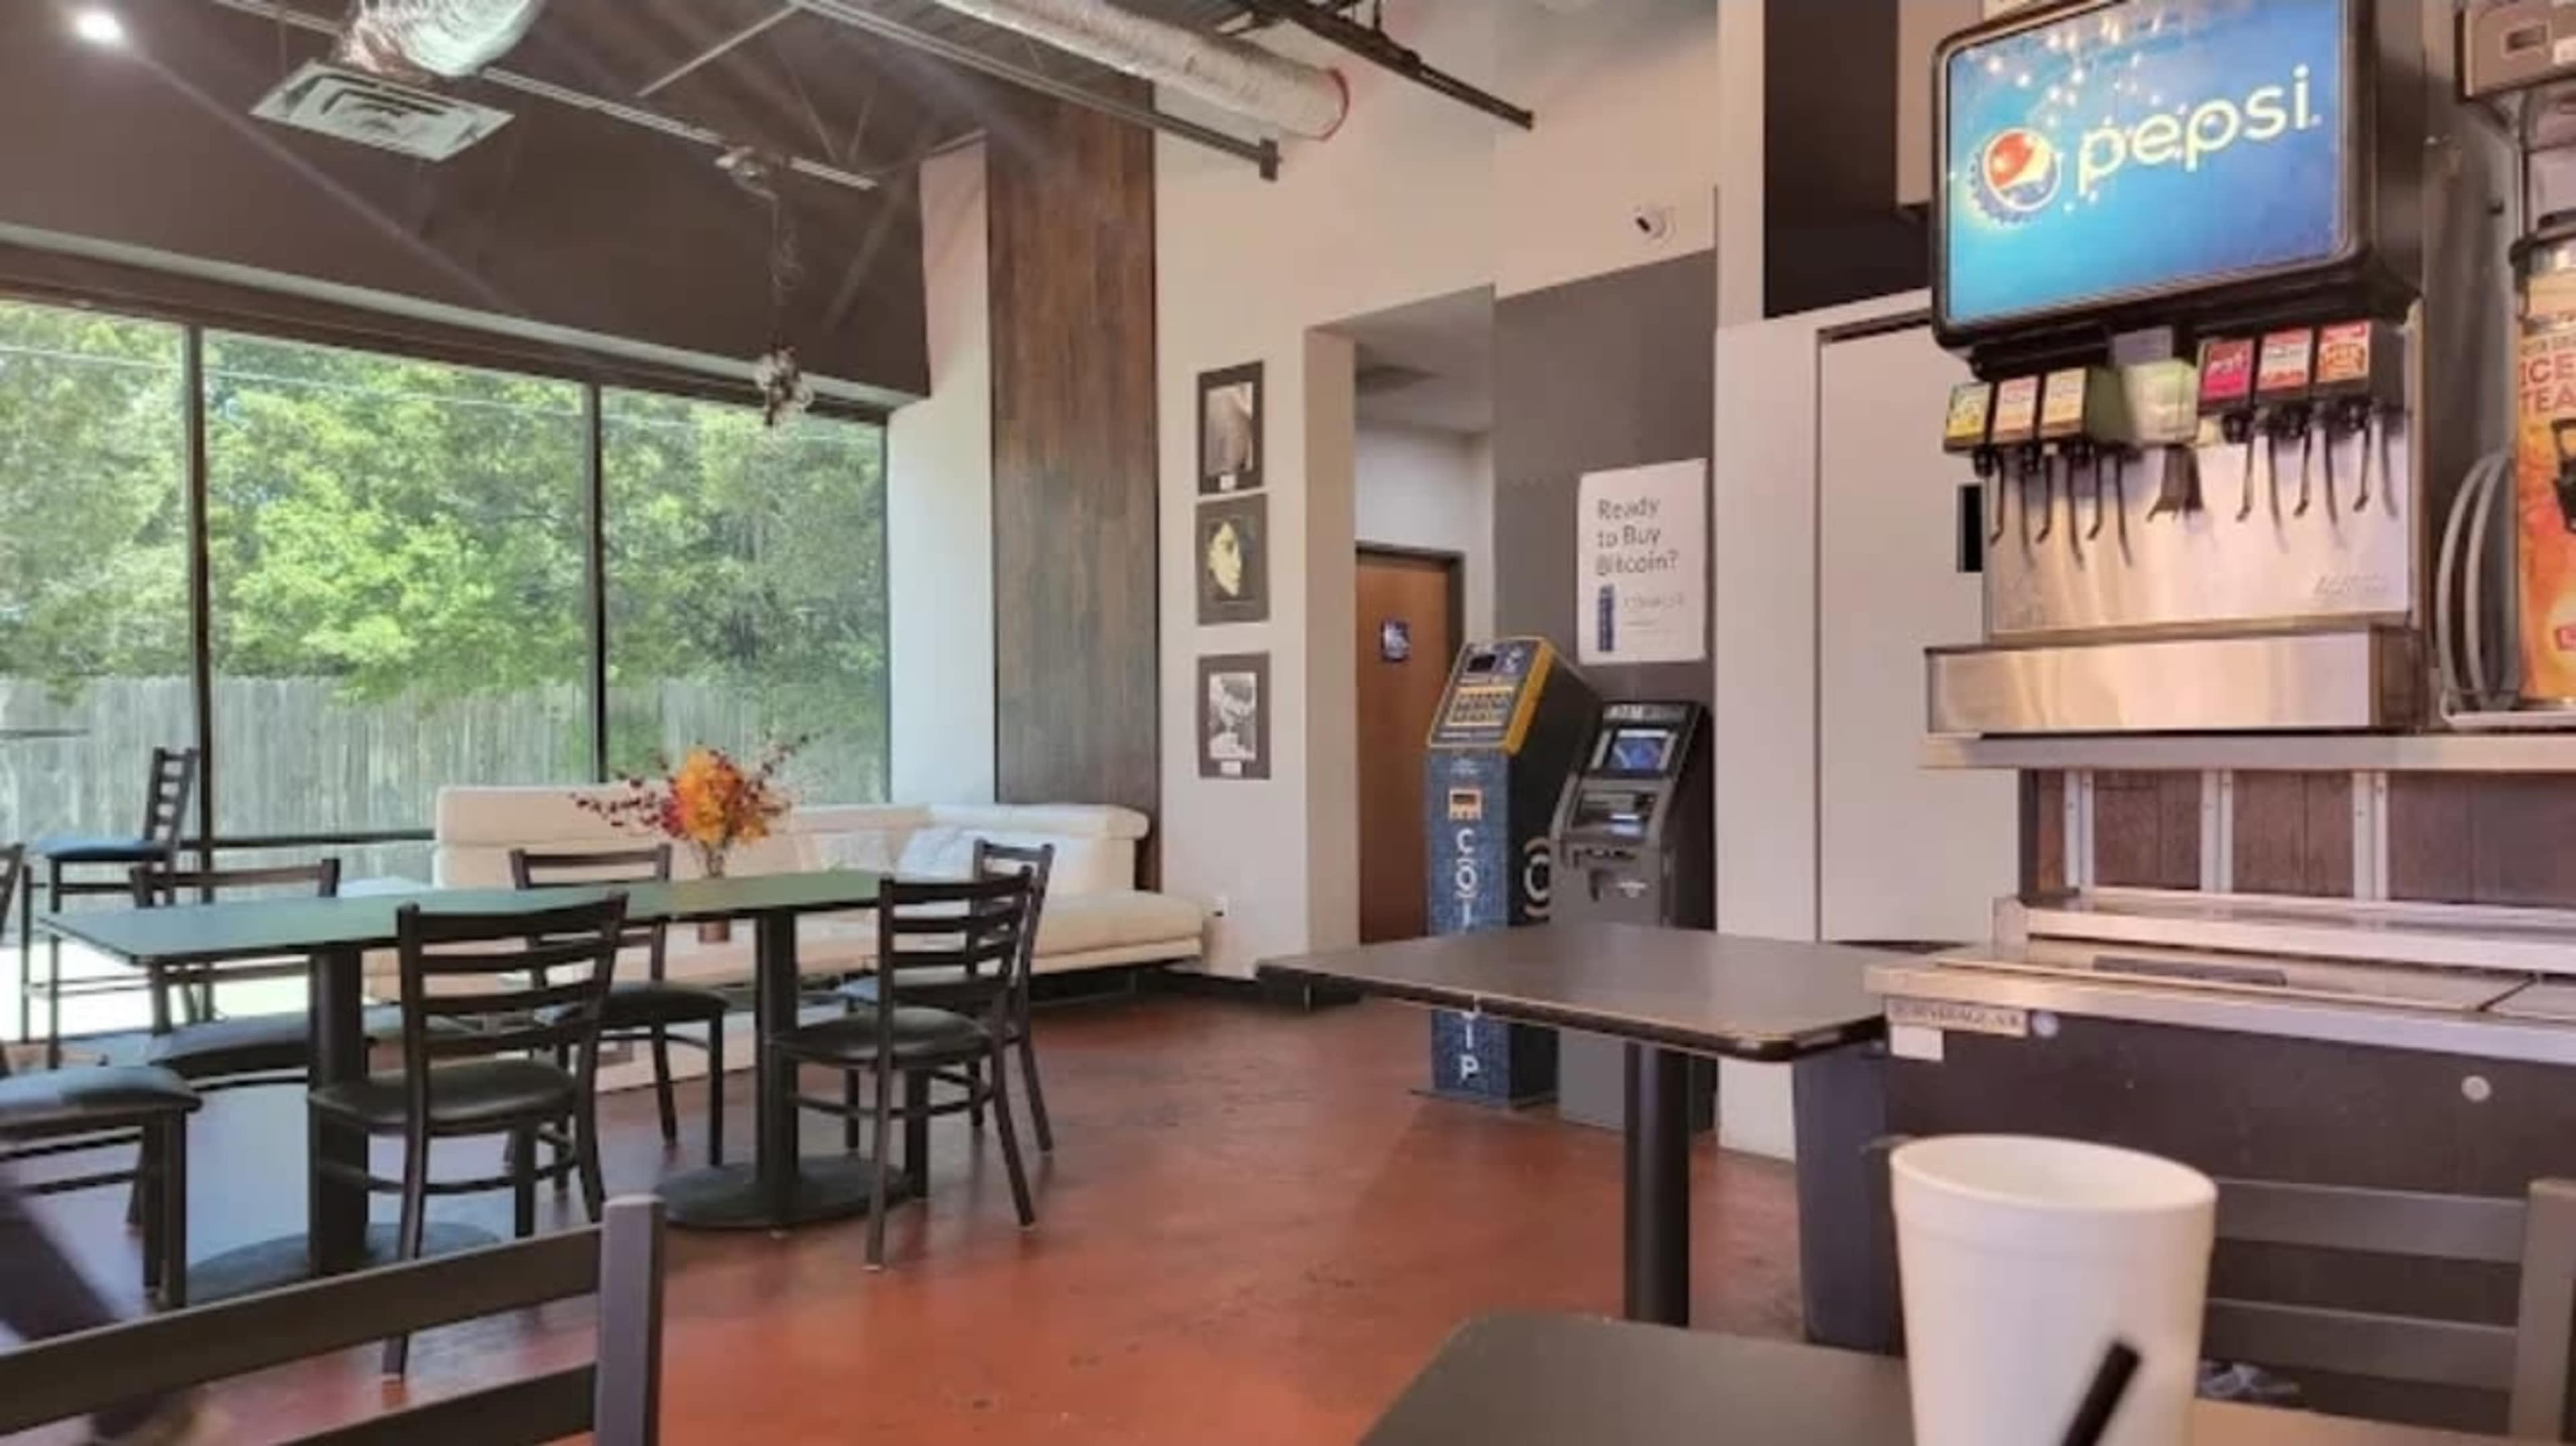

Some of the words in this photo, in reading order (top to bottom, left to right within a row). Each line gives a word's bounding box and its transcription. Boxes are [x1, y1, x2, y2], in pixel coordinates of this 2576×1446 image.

[2077, 64, 2312, 197] pepsi
[1597, 497, 1661, 520] Ready
[1597, 529, 1618, 549] to
[1623, 523, 1661, 546] Buy
[1595, 549, 1680, 577] Bitcoin?
